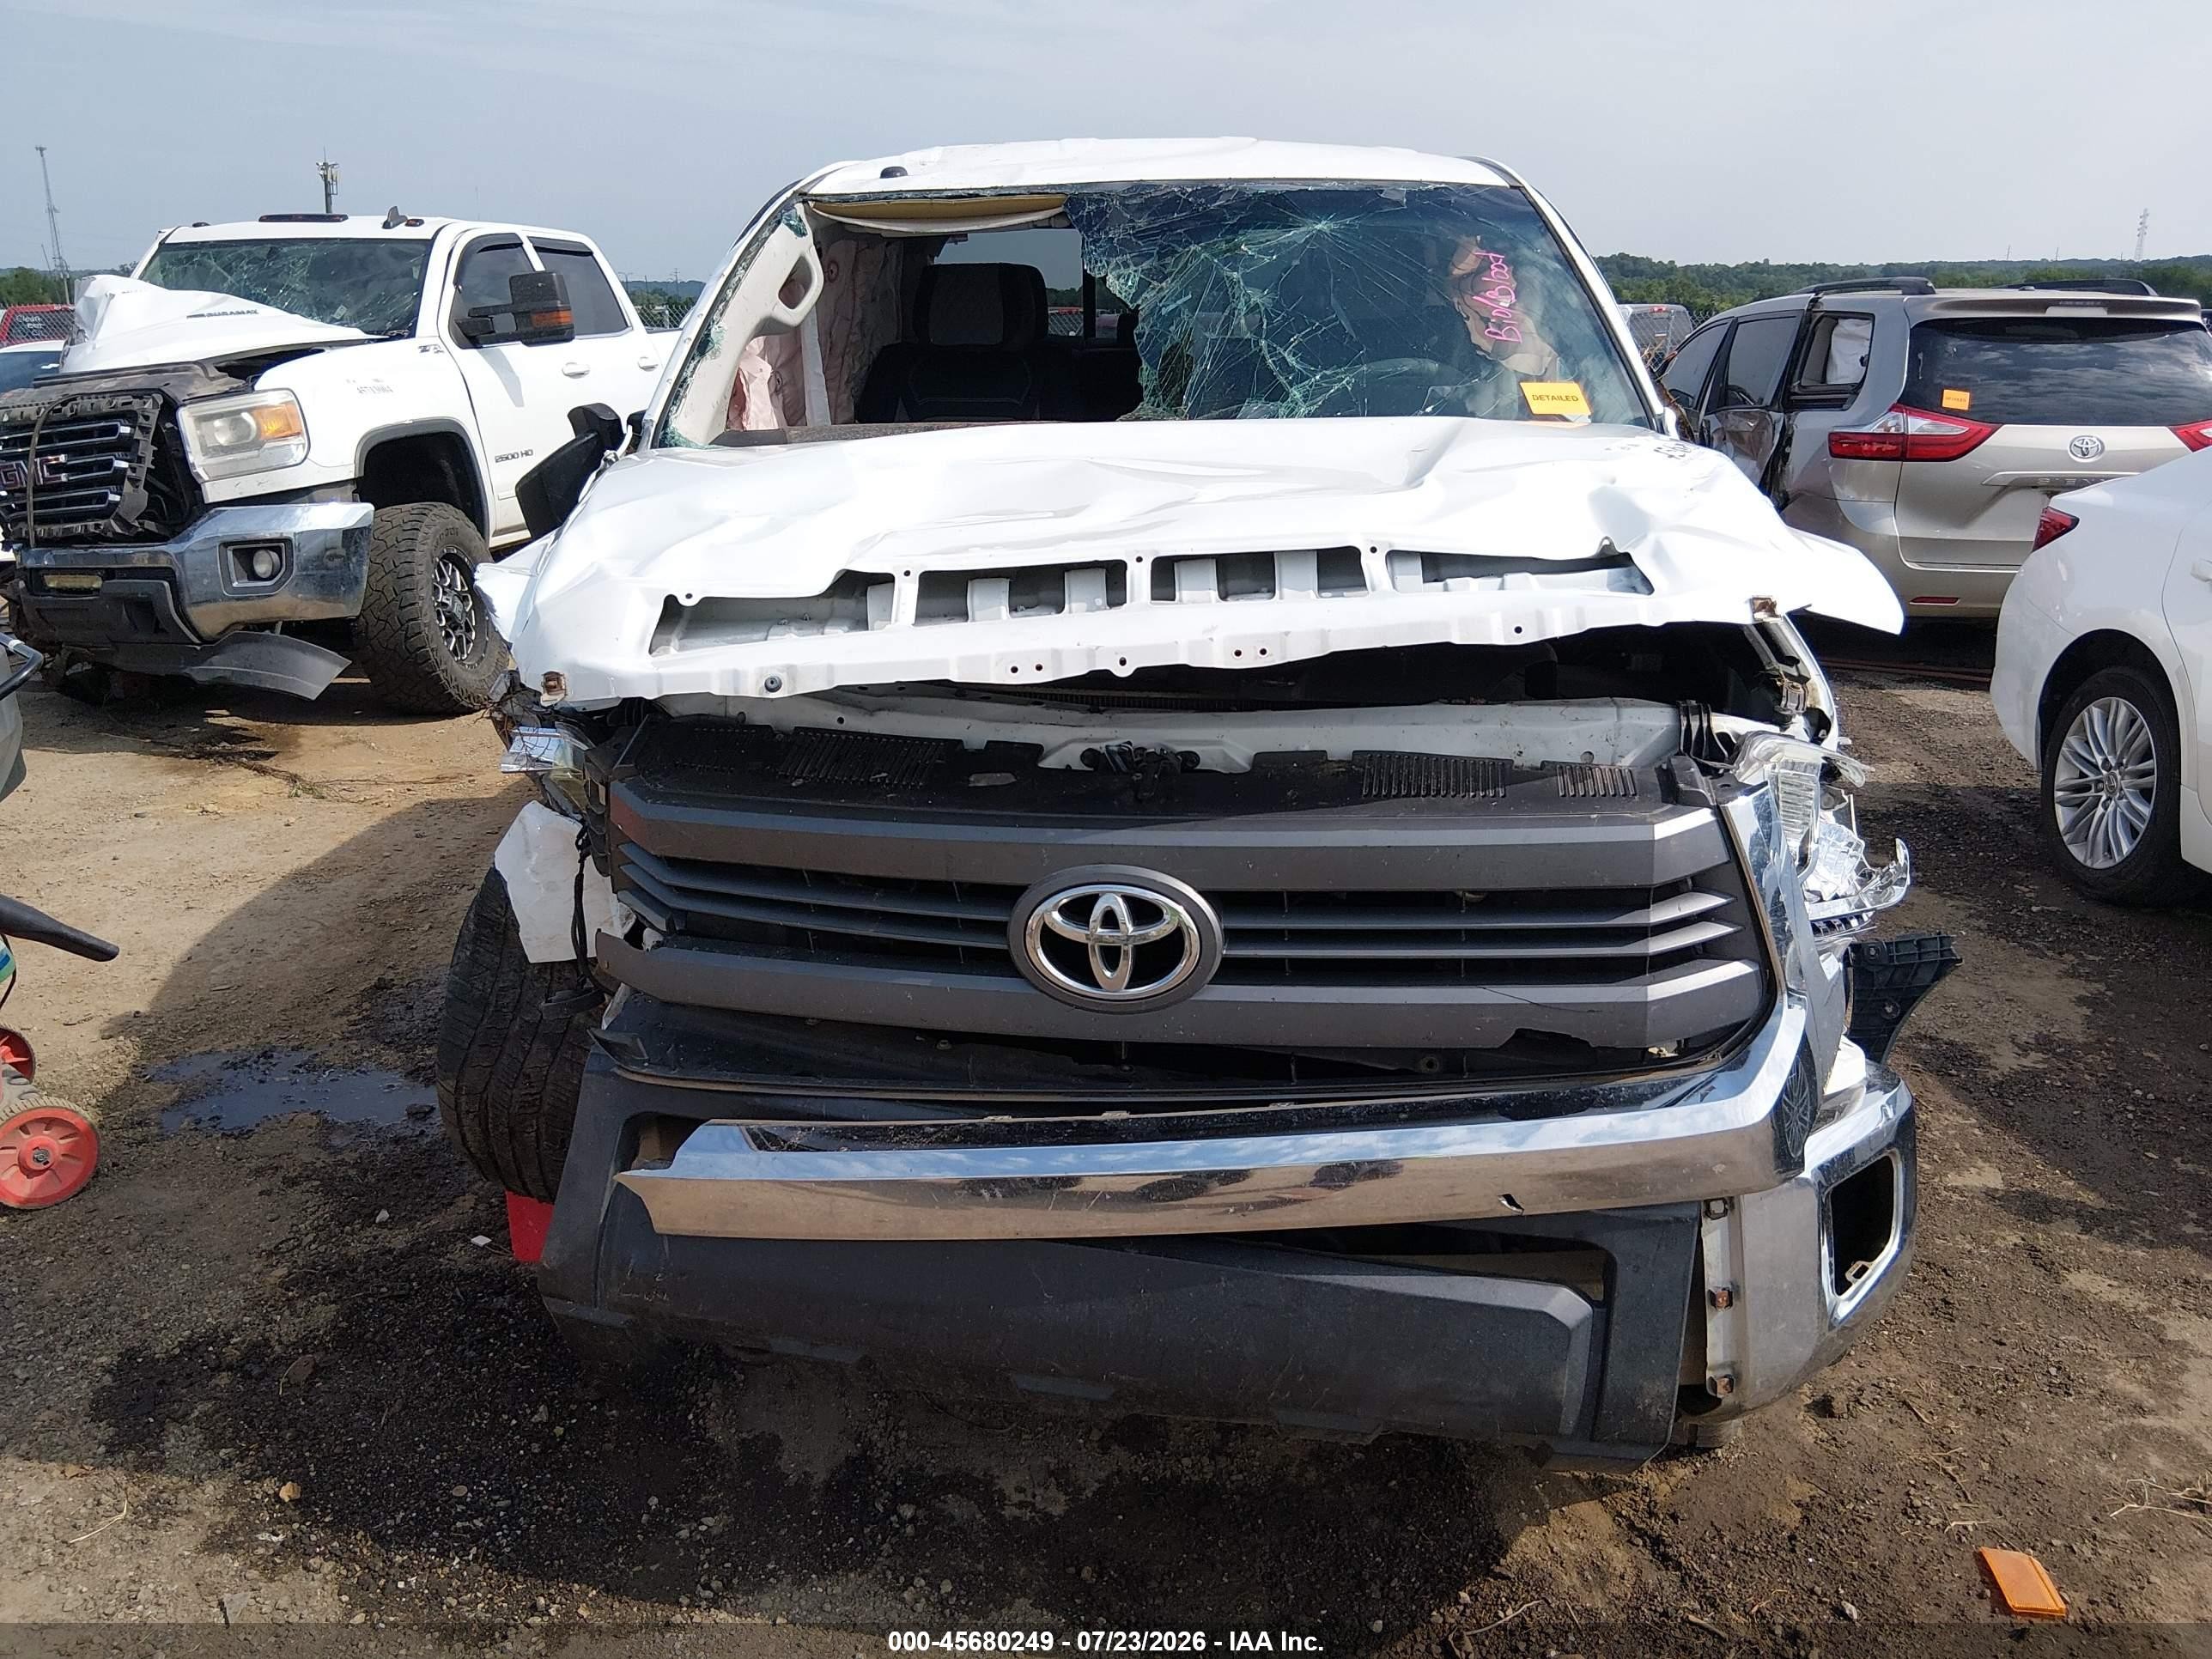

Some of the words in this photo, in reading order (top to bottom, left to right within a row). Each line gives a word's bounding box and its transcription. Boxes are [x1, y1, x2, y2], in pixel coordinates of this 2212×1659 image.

[494, 452, 520, 463] 2500
[520, 448, 534, 458] HD
[0, 453, 69, 489] GMC
